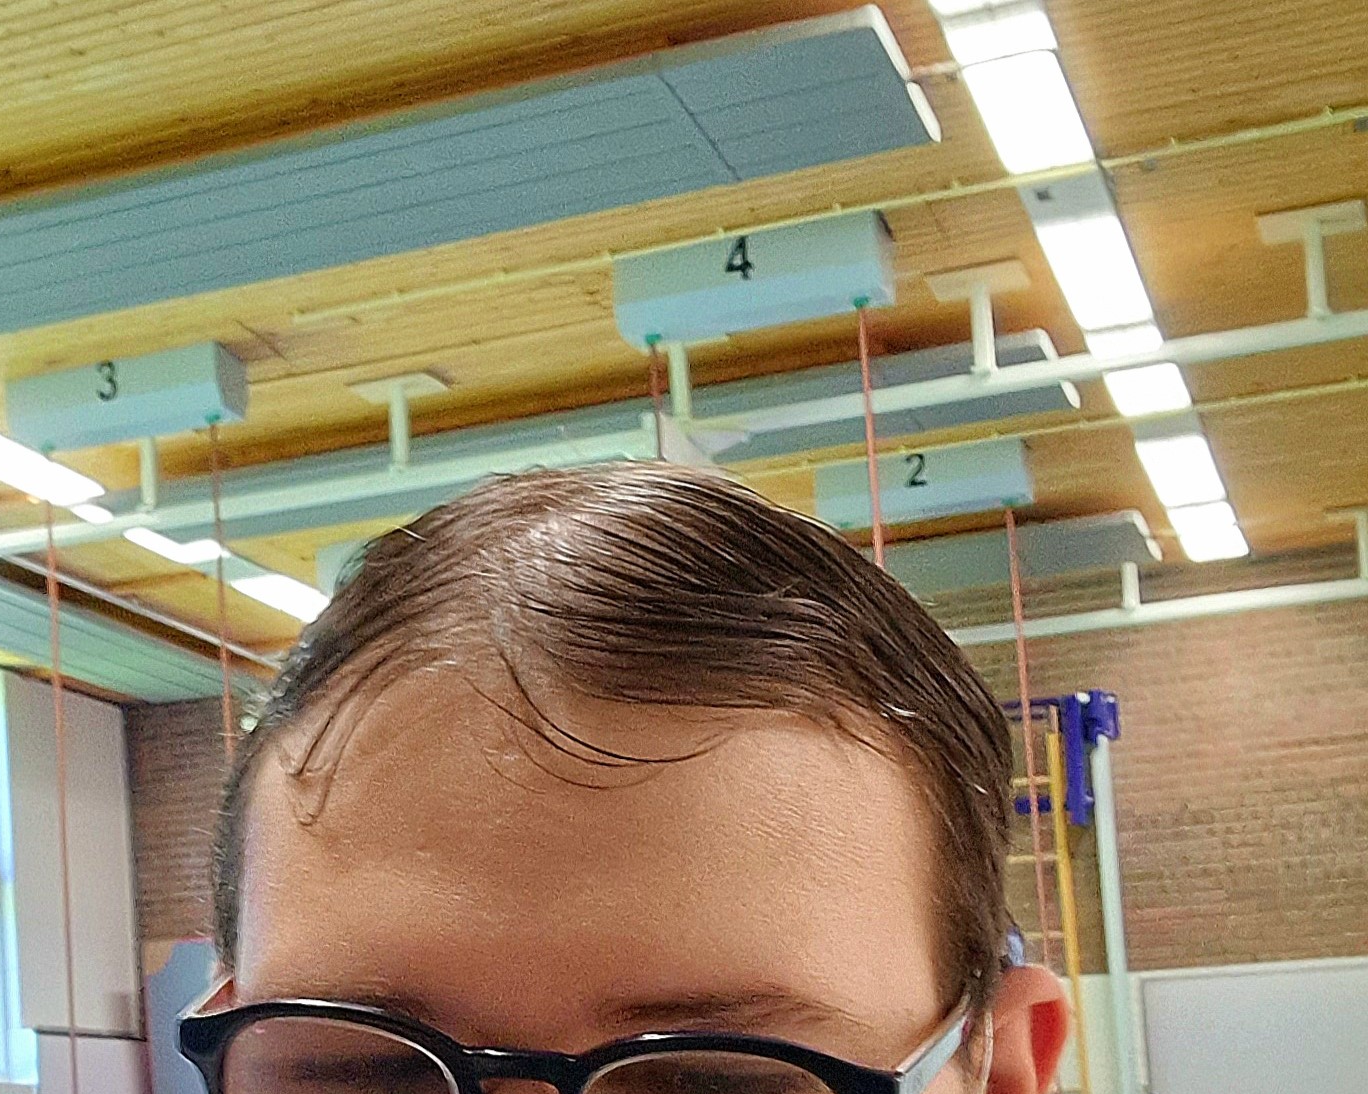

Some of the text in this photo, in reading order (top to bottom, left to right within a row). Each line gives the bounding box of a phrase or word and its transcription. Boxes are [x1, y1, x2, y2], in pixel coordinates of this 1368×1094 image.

[725, 236, 754, 281] 4
[96, 360, 119, 401] 3
[905, 453, 927, 487] 2
